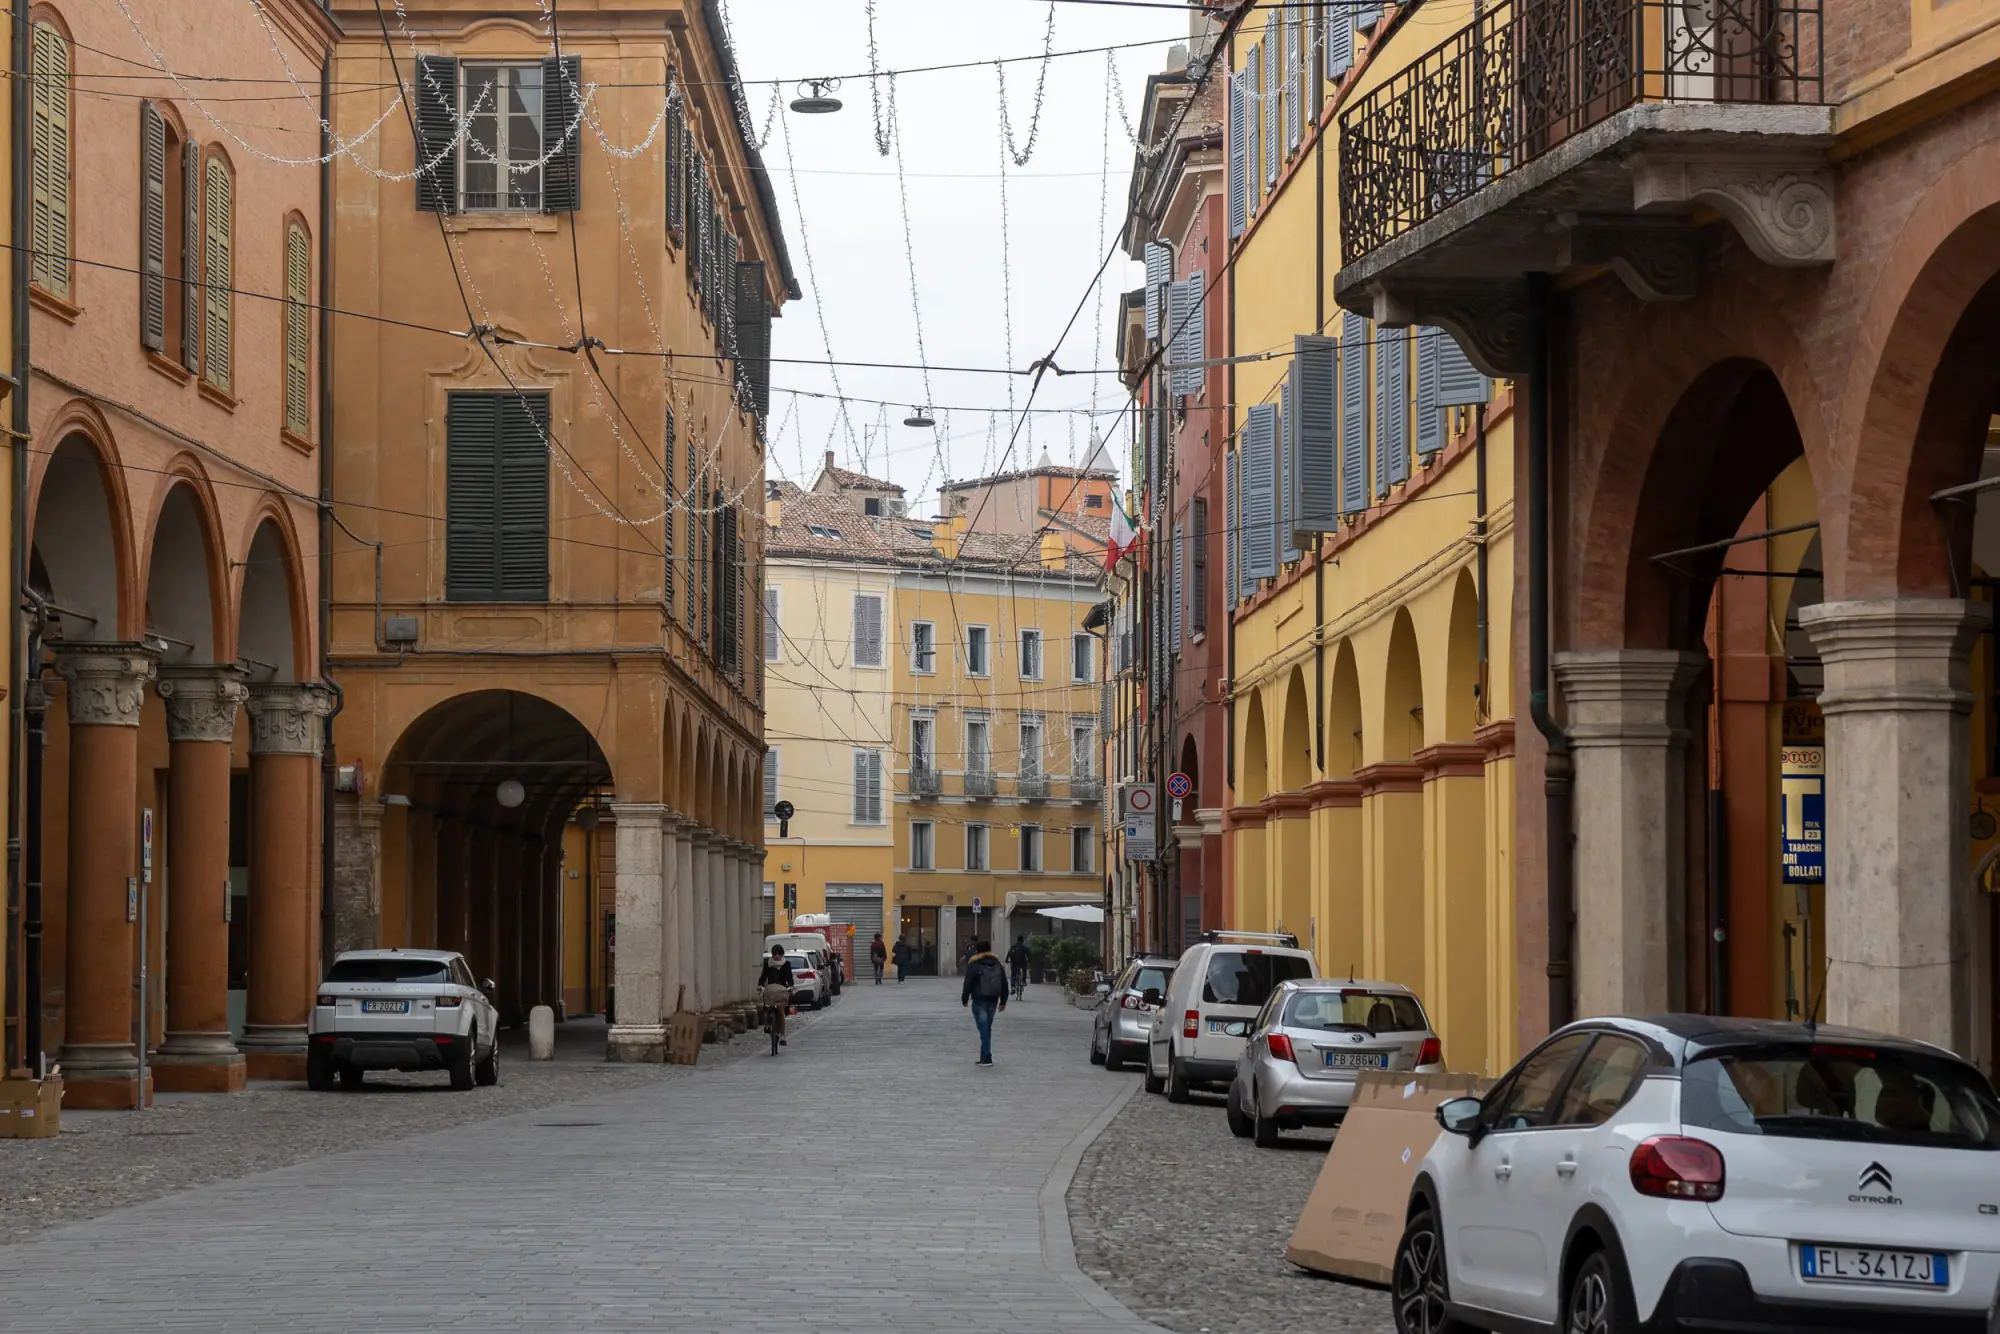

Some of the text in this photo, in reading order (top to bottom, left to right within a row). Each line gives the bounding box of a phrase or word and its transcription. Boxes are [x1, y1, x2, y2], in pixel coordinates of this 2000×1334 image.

[1782, 778, 1821, 840] T
[1807, 831, 1818, 839] 23
[1788, 843, 1822, 852] TABACCHI
[1788, 865, 1822, 877] BOLLATI
[1978, 1204, 1998, 1215] C3
[1819, 1250, 1931, 1280] FL 341ZJ
